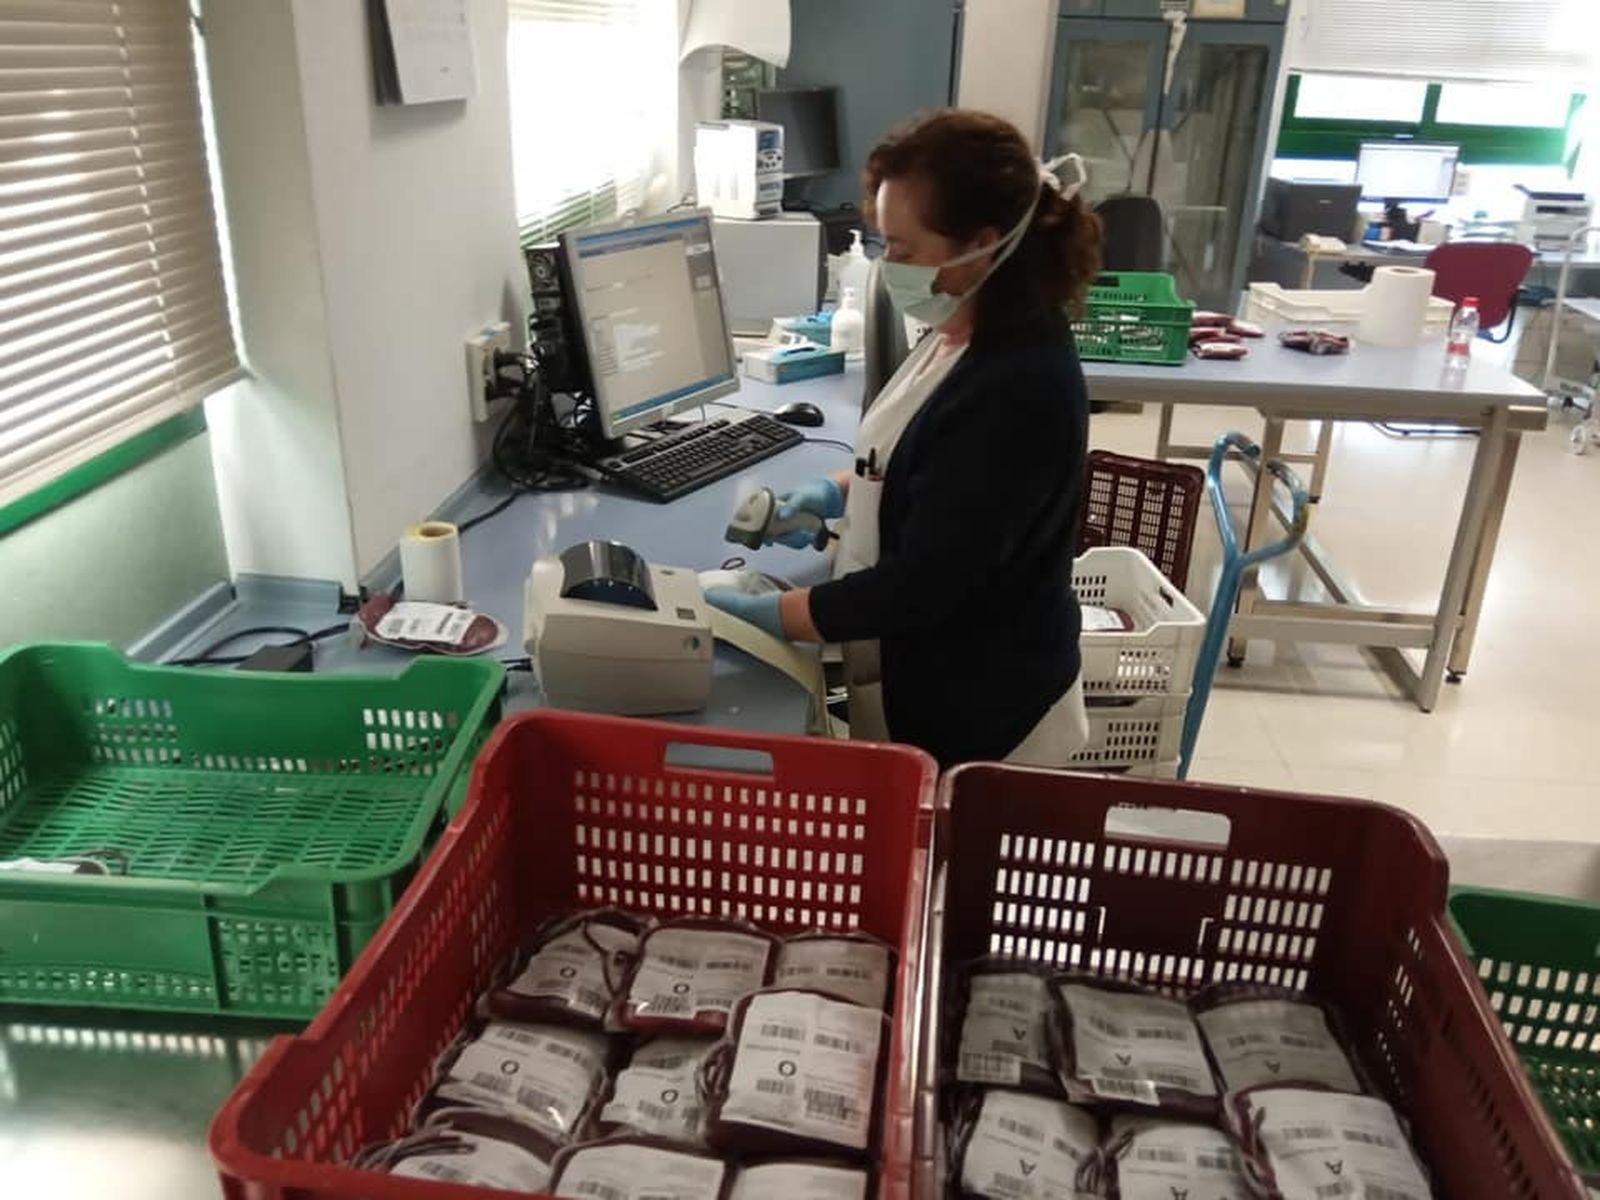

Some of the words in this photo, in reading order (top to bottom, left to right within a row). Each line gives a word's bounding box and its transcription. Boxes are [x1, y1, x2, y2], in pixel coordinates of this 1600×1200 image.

[673, 983, 690, 995] O
[501, 1060, 519, 1076] O
[778, 1060, 796, 1076] O
[661, 1089, 679, 1105] O
[1020, 1159, 1037, 1176] A
[1325, 1160, 1342, 1176] A
